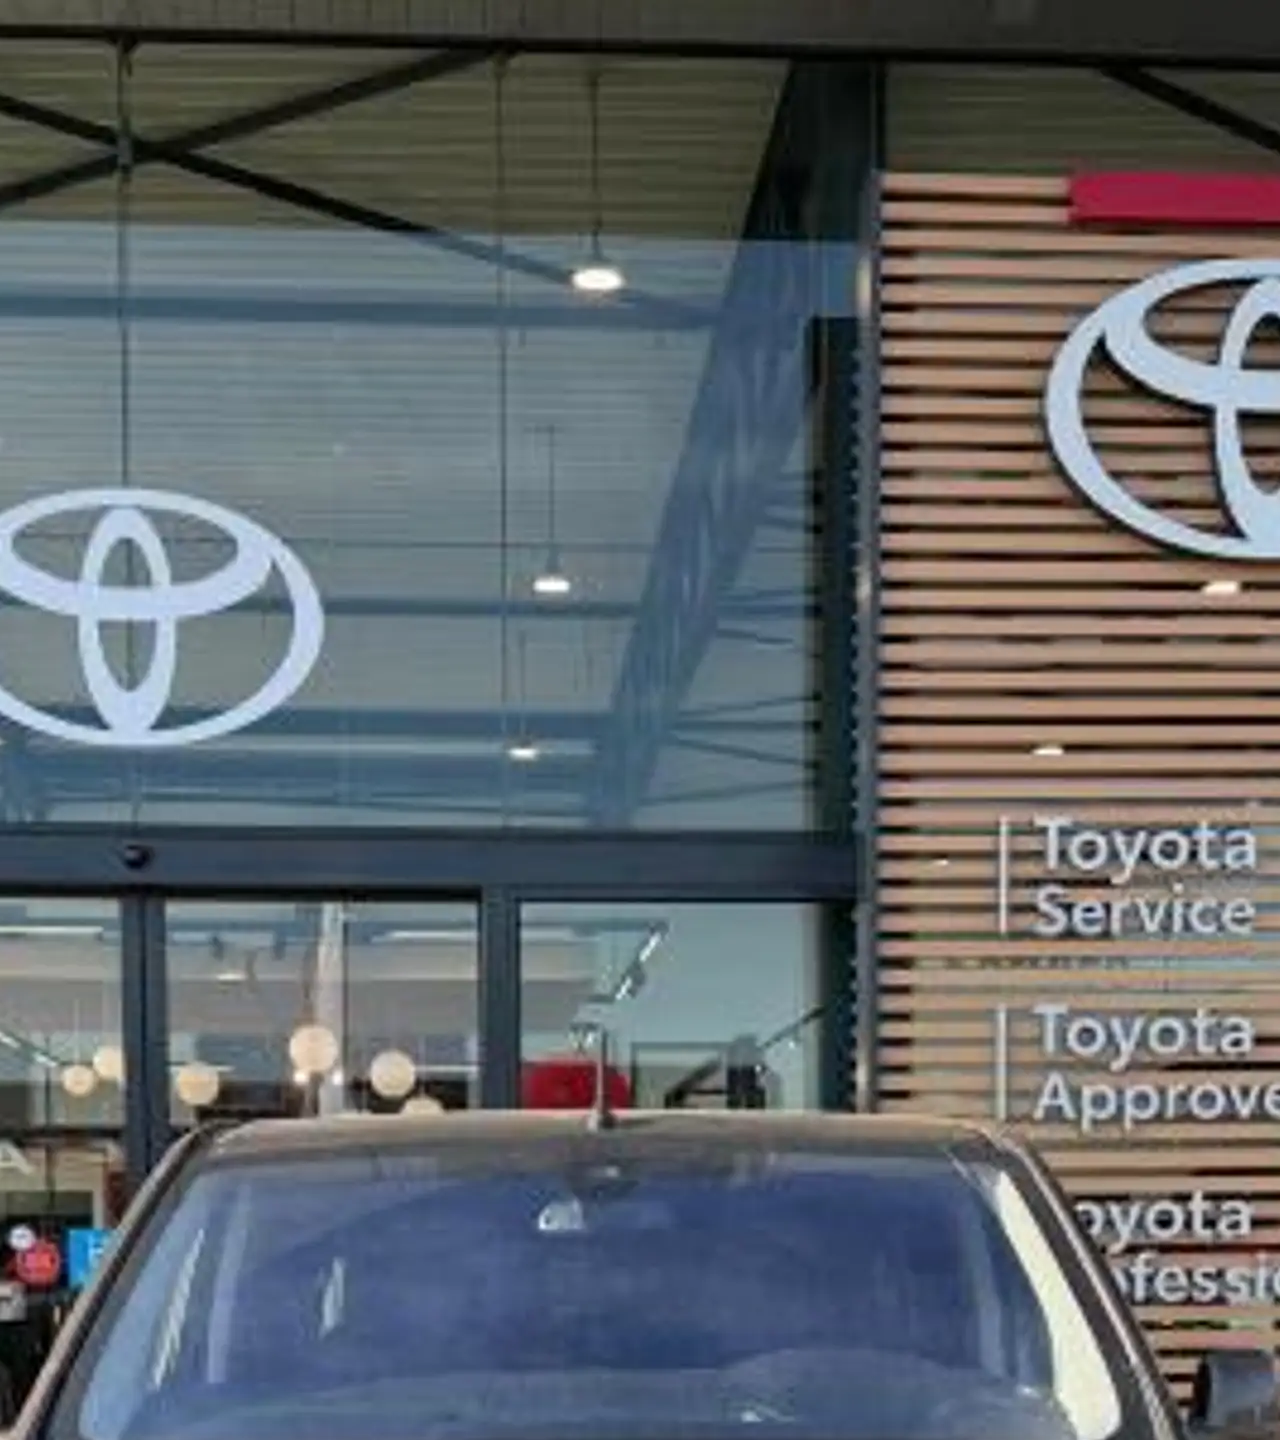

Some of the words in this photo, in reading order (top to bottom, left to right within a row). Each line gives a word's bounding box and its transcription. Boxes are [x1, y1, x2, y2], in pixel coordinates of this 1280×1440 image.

[1033, 815, 1257, 884] Toyota
[1032, 883, 1256, 937] Service
[1032, 1004, 1255, 1071] Toyota
[1074, 1189, 1255, 1255] oyota
